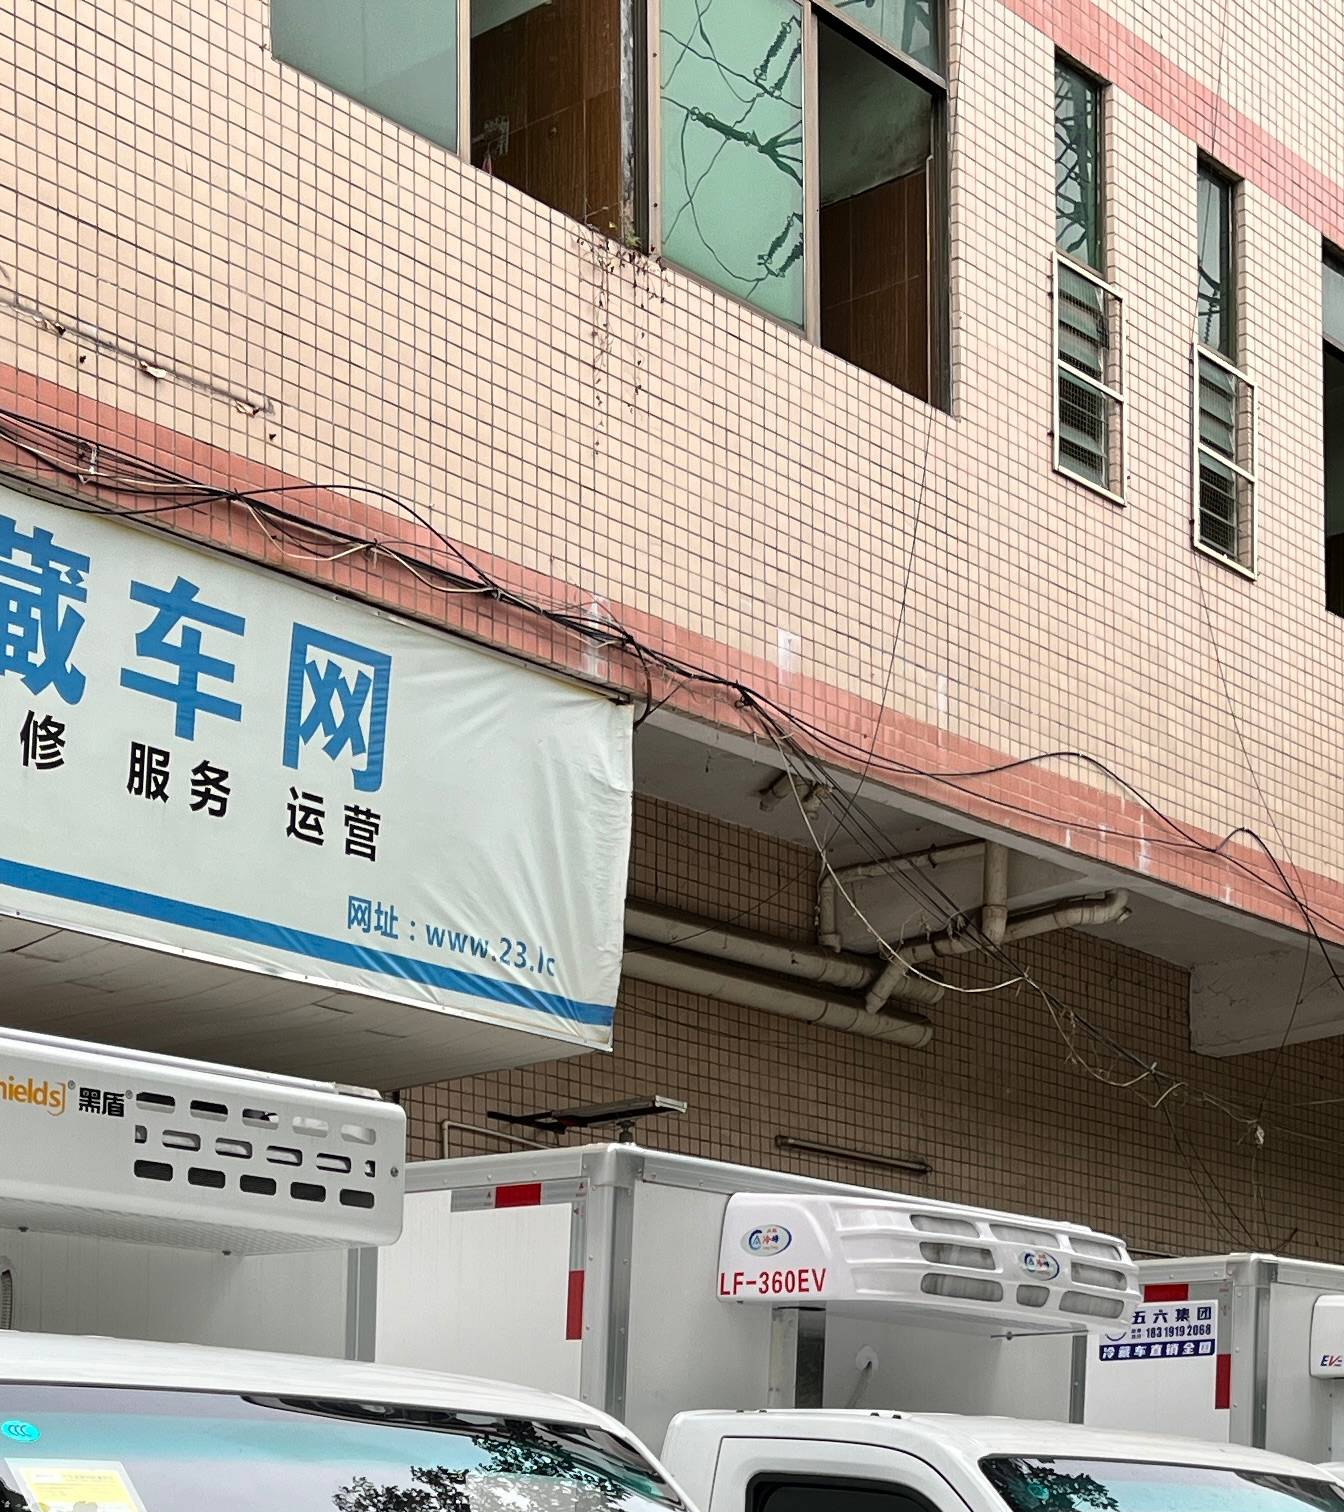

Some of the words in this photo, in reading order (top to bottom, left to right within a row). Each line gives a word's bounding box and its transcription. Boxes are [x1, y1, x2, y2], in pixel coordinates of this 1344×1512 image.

[126, 741, 231, 818] 服务
[285, 786, 382, 862] 运营
[79, 1086, 125, 1117] 黑盾
[719, 1267, 827, 1296] LF-360EV
[1131, 1307, 1212, 1325] 五六集团
